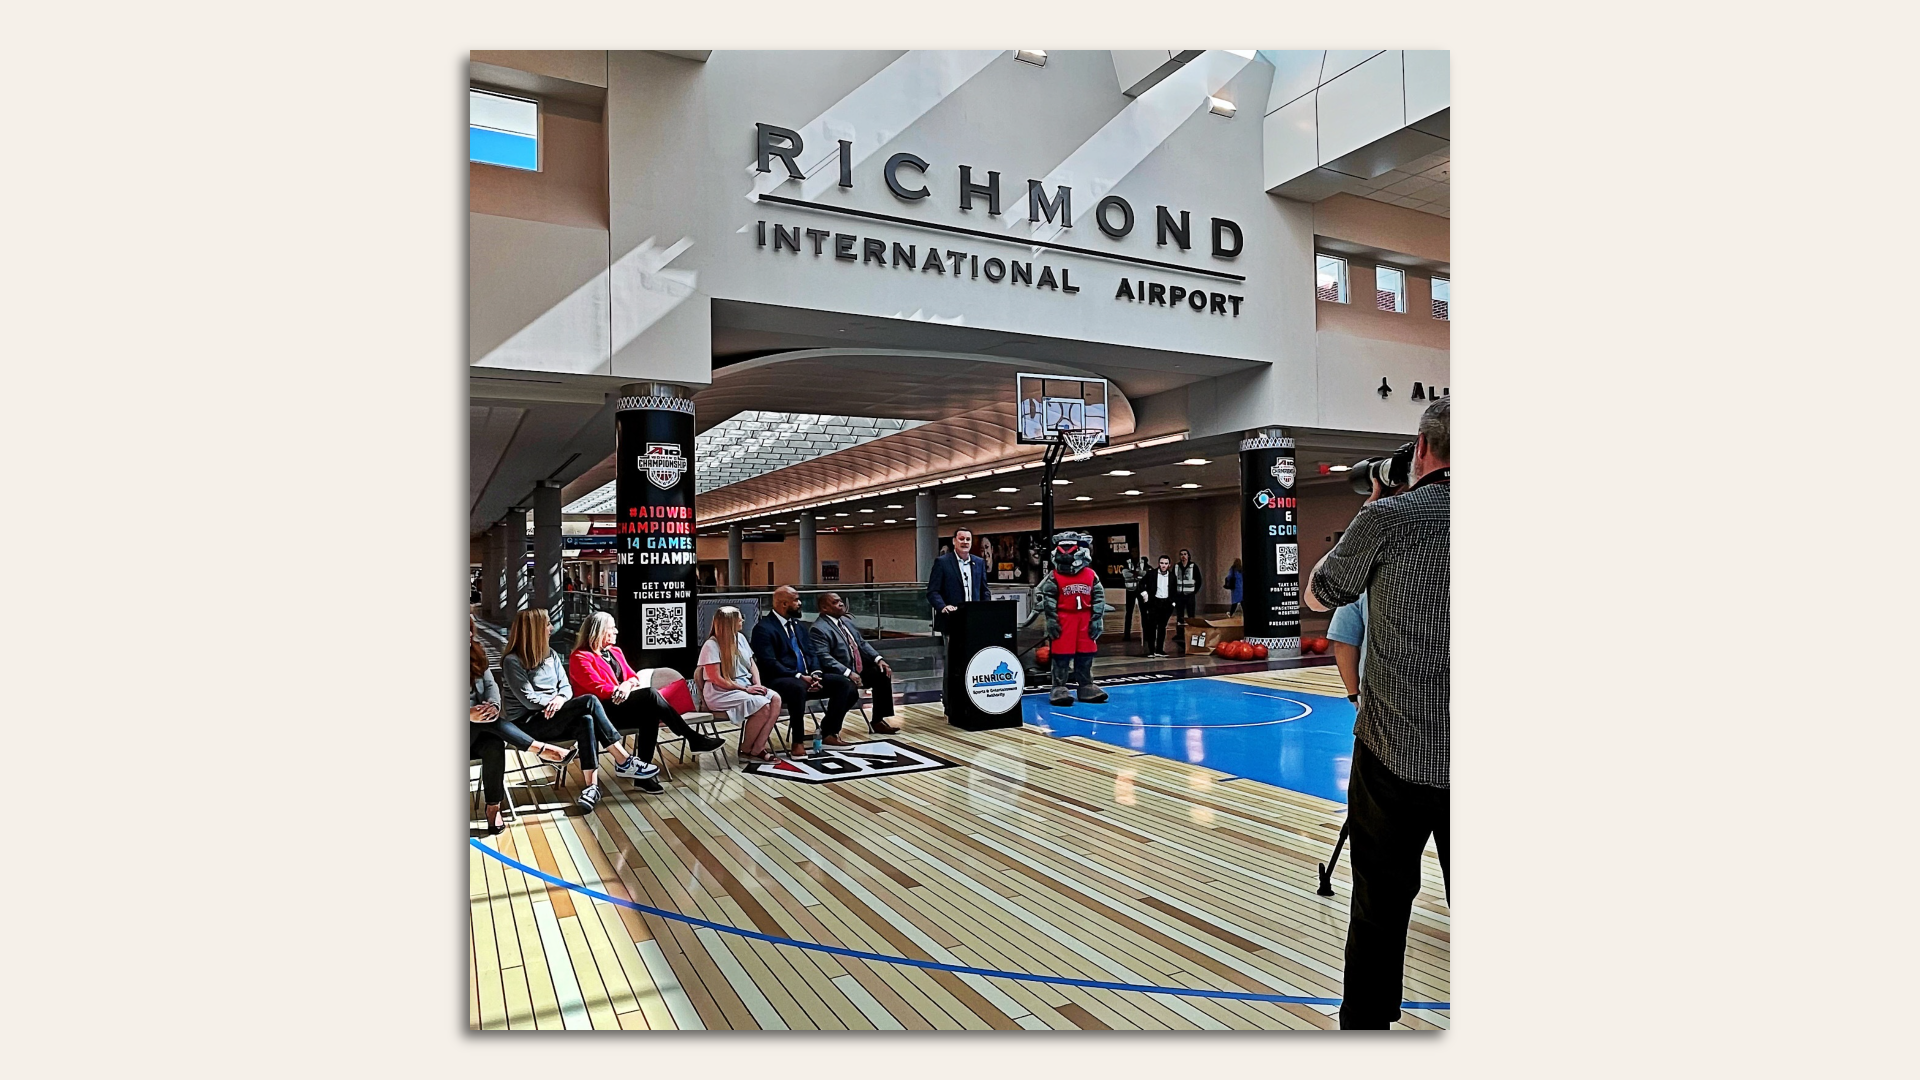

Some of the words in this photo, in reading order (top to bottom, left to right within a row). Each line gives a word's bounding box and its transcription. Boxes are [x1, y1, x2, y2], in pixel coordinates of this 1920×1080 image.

[755, 121, 1245, 260] RICHMOND
[757, 219, 1080, 293] INTERNATIONAL
[1115, 277, 1244, 318] AIRPORT
[638, 459, 687, 469] CHAMPIONSHIP
[627, 537, 640, 550] 14
[641, 581, 660, 590] GET
[662, 581, 685, 590] YOUR
[633, 590, 672, 600] TICKETS
[674, 590, 692, 598] NOW
[1076, 595, 1082, 610] 1
[972, 672, 1012, 684] HENRICO
